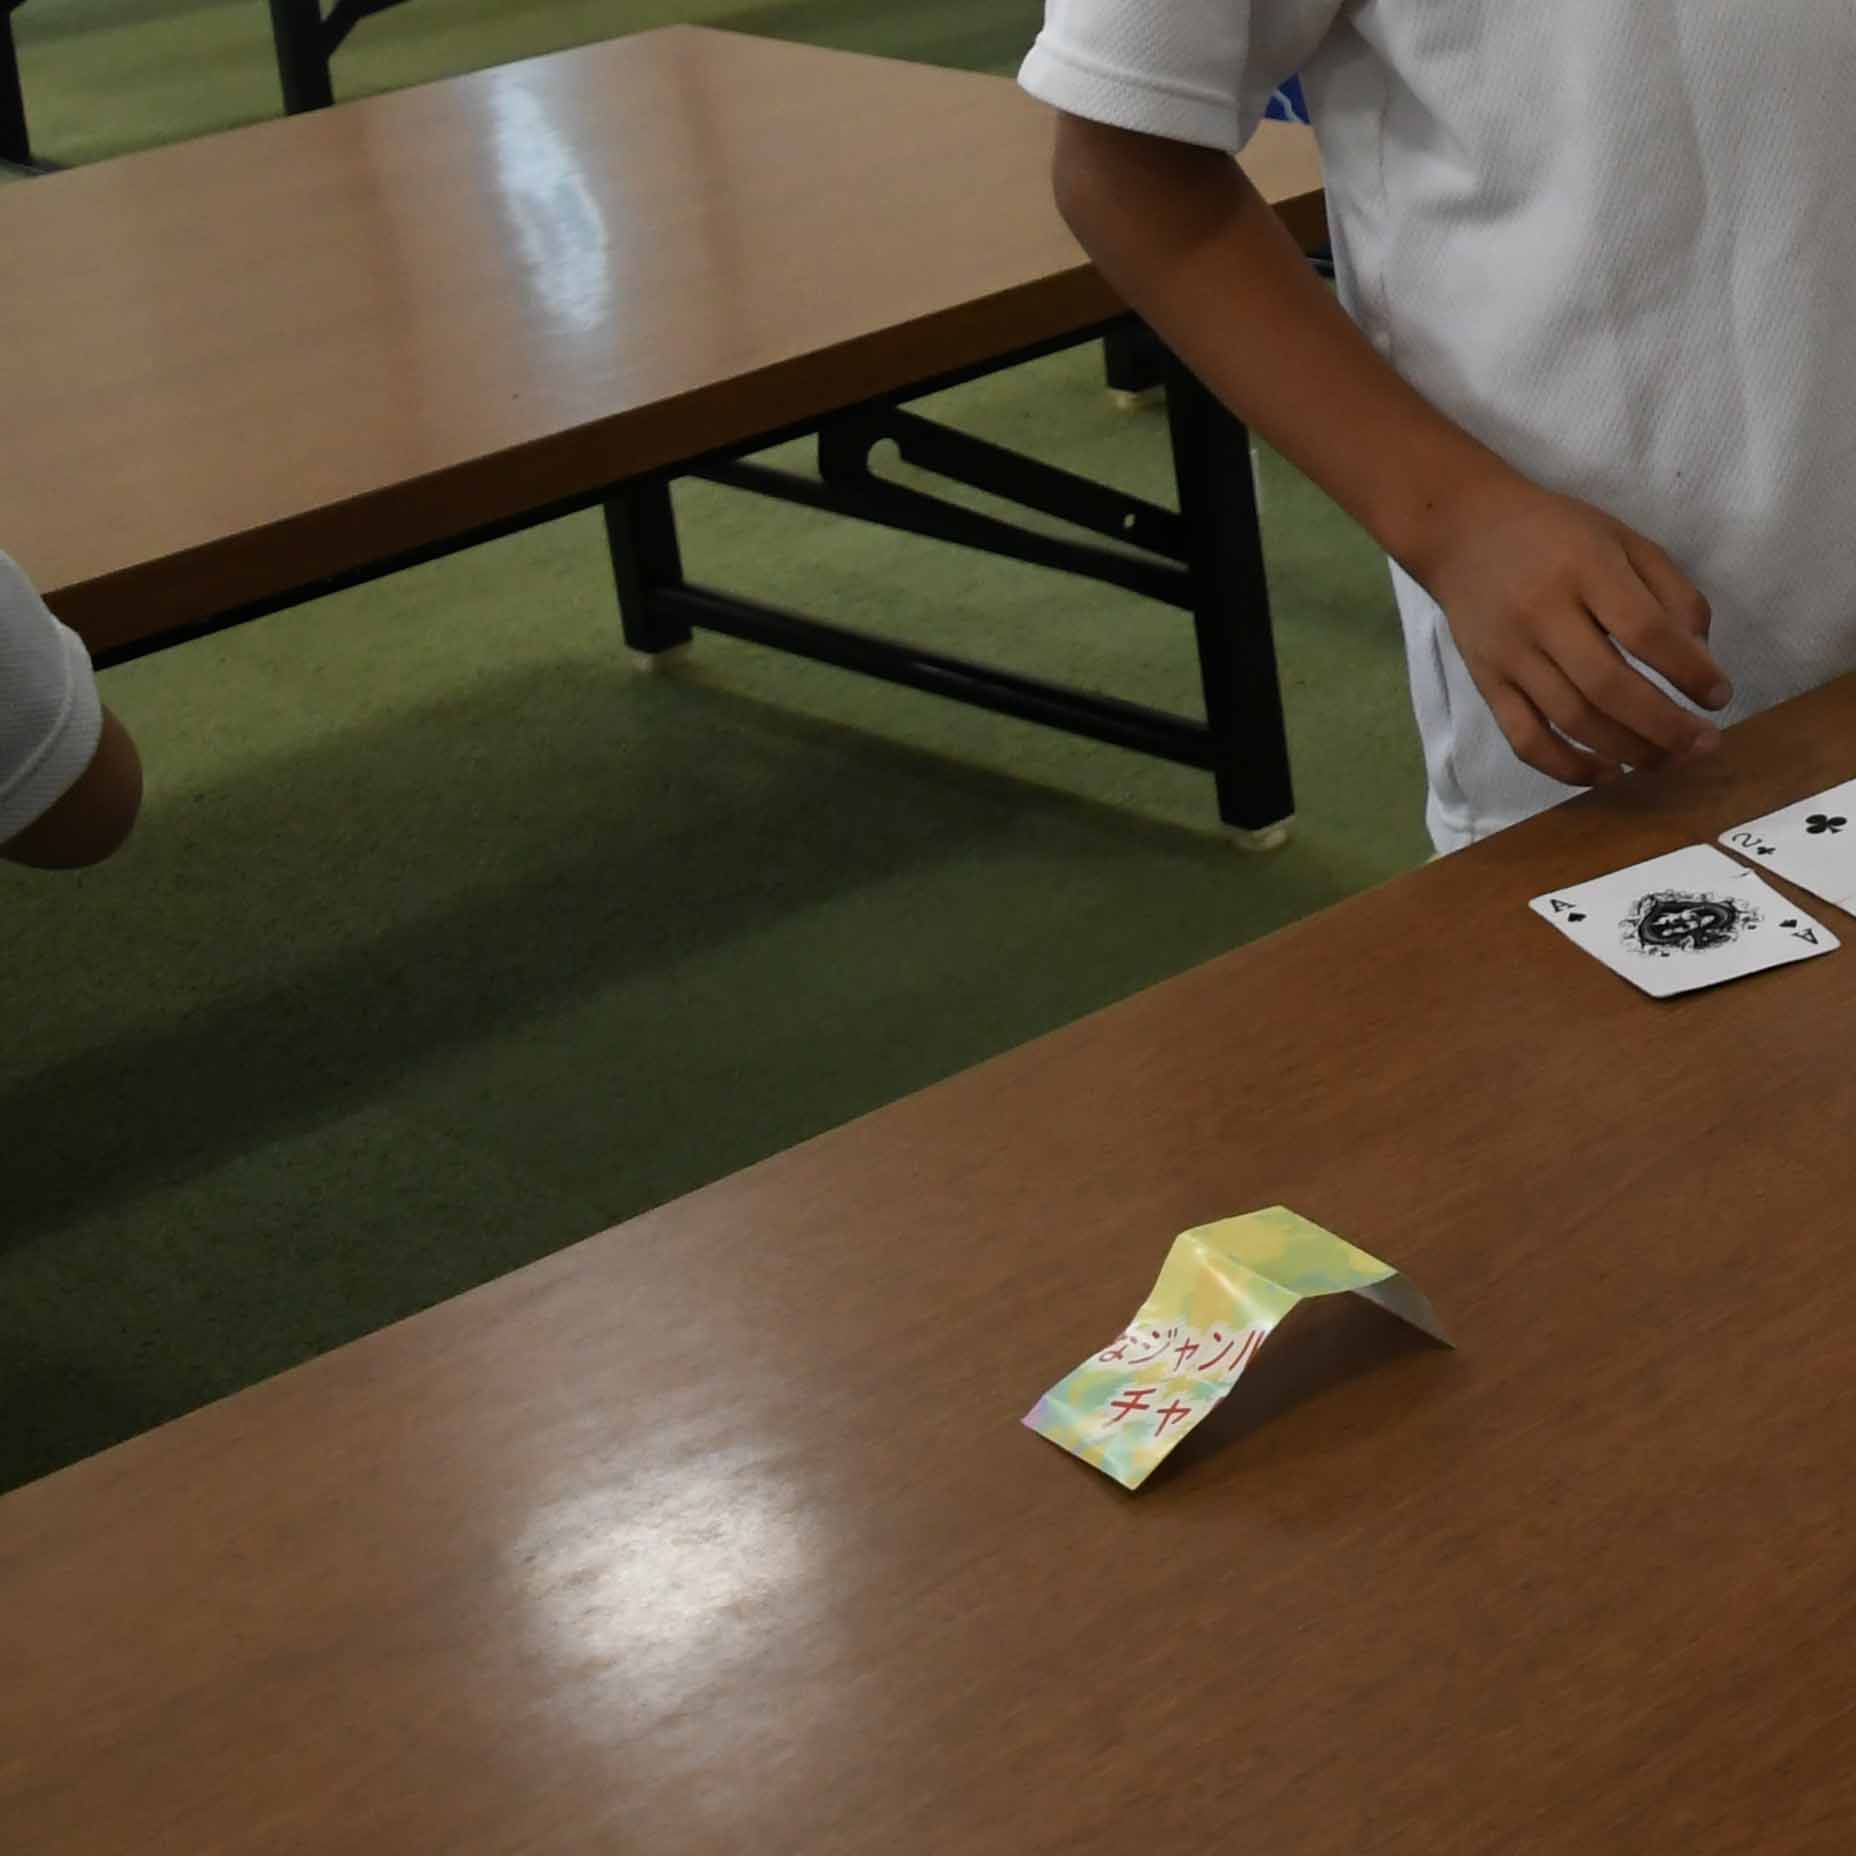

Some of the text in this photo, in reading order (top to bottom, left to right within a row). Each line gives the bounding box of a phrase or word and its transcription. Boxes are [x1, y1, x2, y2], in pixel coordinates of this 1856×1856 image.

[1731, 832, 1763, 848] 2
[1550, 897, 1577, 913] A
[1793, 929, 1820, 946] A
